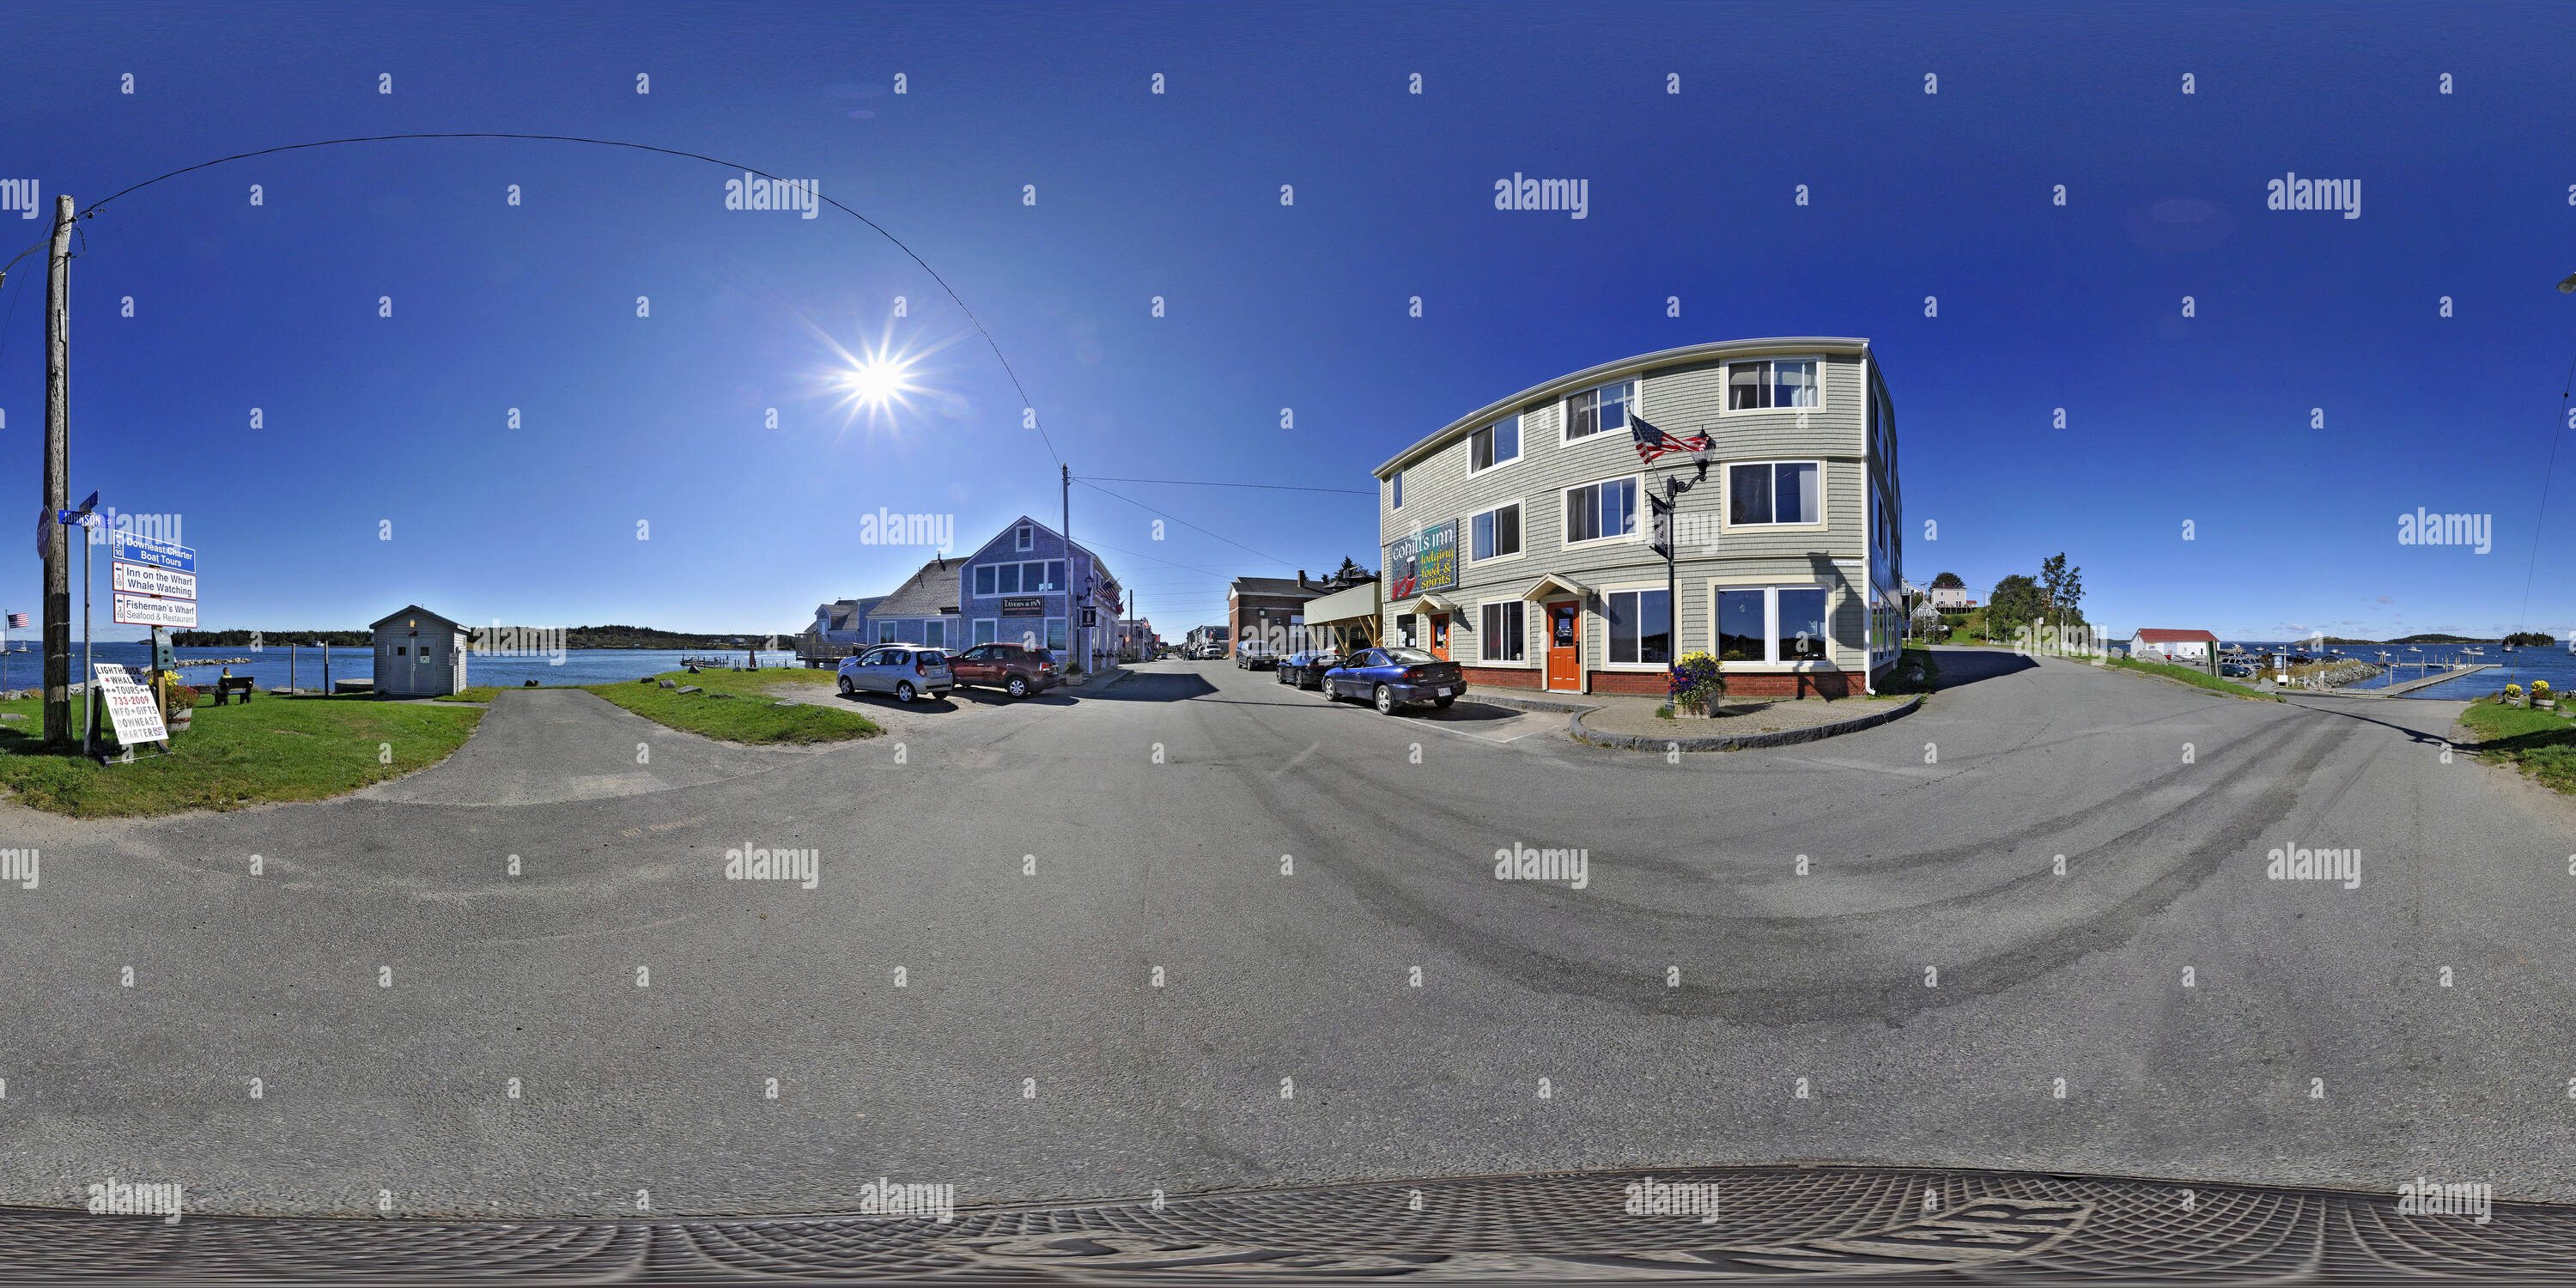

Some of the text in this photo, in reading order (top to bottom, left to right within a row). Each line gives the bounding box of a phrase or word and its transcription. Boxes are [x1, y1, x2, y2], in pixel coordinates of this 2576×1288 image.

[62, 512, 100, 526] JOHNSON
[38, 519, 50, 547] STOP
[126, 538, 193, 560] Downeast Charter
[141, 550, 182, 567] Boat Tours
[1421, 548, 1454, 565] lodging
[126, 567, 192, 586] Inn on the Wharf
[1421, 560, 1452, 579] food &
[128, 579, 191, 598] Whale Watching
[1421, 574, 1451, 591] spirits
[126, 600, 194, 615] Fisherman's Wharf
[126, 611, 155, 621] Seafood
[163, 613, 194, 623] Restaurant
[95, 666, 141, 675] LIGHTHOUSE
[110, 676, 137, 684] WHALE
[116, 686, 141, 695] TOURS
[112, 696, 149, 706] 733-2009
[112, 706, 158, 717] INFO GIFTS
[117, 716, 159, 728] DOWNEAST
[118, 727, 154, 739] CHARTER
